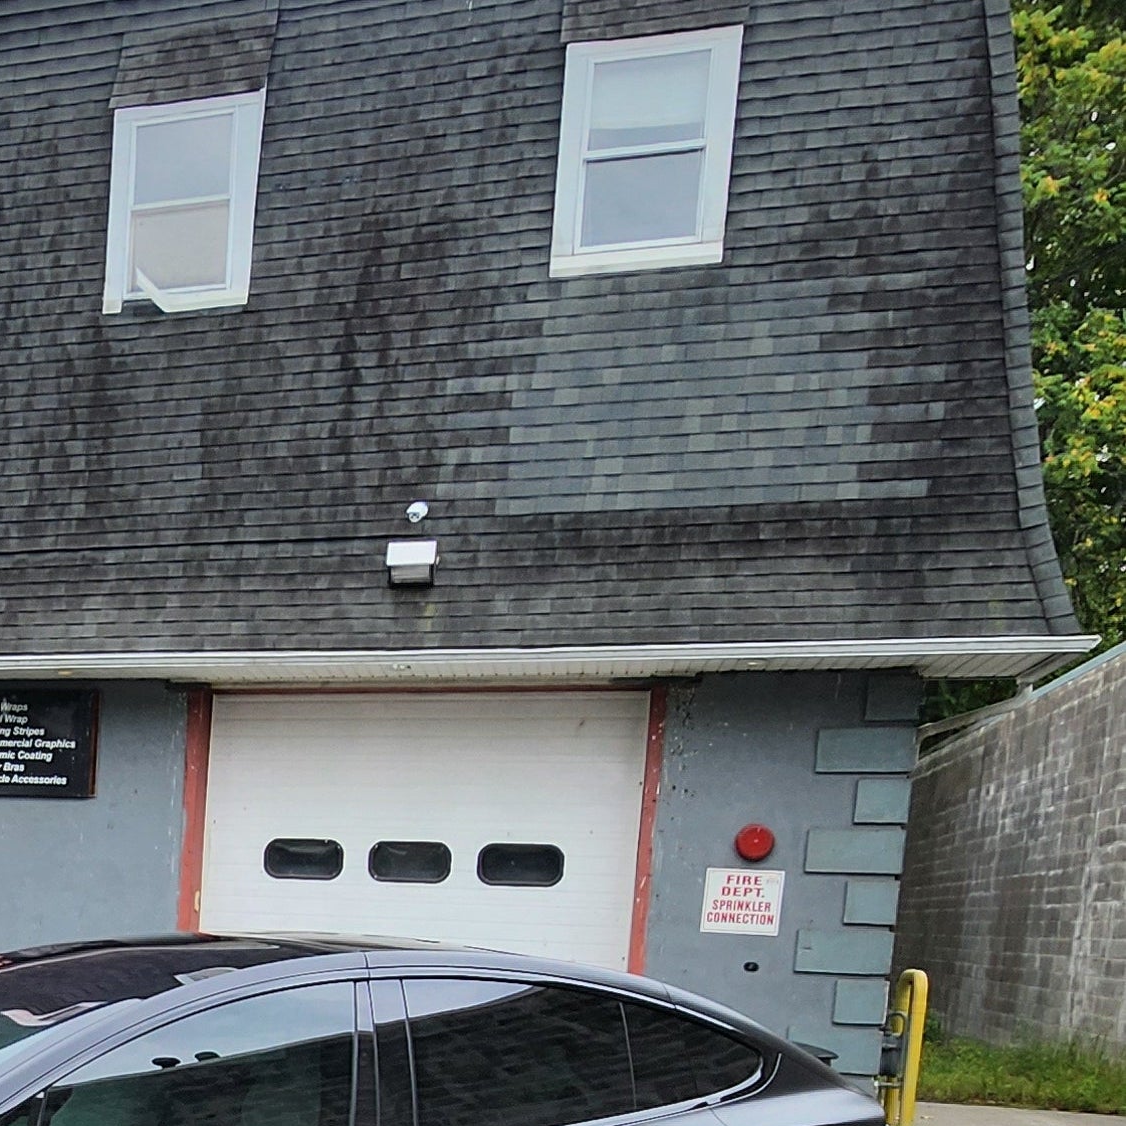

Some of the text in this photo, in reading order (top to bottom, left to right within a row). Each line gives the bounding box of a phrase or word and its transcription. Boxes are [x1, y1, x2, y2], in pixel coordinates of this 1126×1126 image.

[0, 702, 28, 712] Wraps
[4, 714, 28, 725] Wrap
[13, 726, 45, 737] Stripes
[34, 738, 76, 750] Graphics
[17, 750, 53, 762] Coating
[11, 774, 68, 785] Accessories
[726, 874, 763, 886] FIRE
[721, 886, 765, 898] DEPT.
[712, 899, 772, 913] SPRINKLER
[706, 912, 774, 925] CONNECTION
